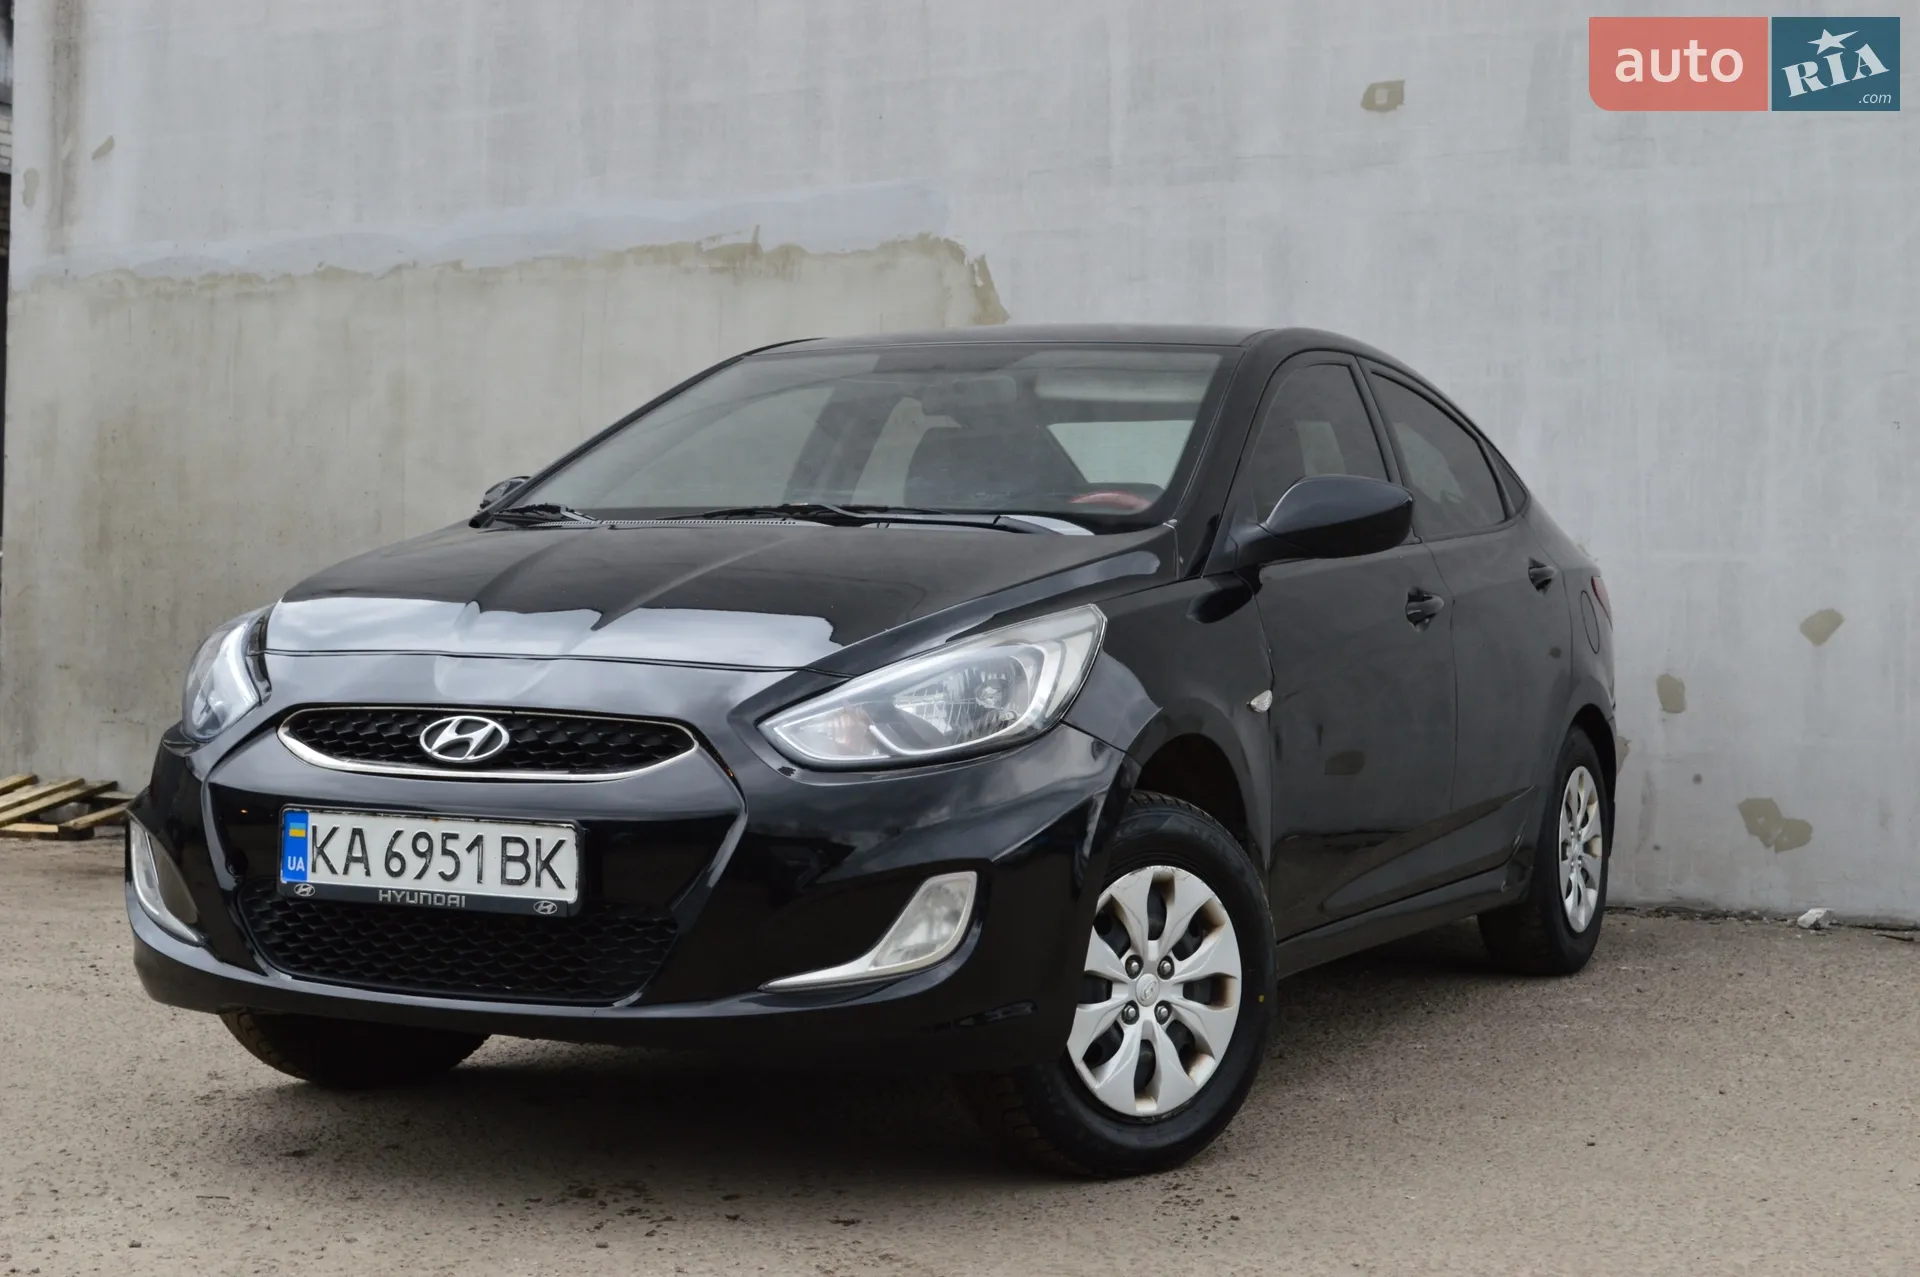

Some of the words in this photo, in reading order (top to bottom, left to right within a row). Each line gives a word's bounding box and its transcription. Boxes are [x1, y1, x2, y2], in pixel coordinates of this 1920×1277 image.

[287, 856, 305, 872] UA
[311, 824, 371, 877] KA
[384, 829, 485, 884] 6951
[501, 836, 567, 889] BK
[378, 889, 466, 908] HYUNDAI
